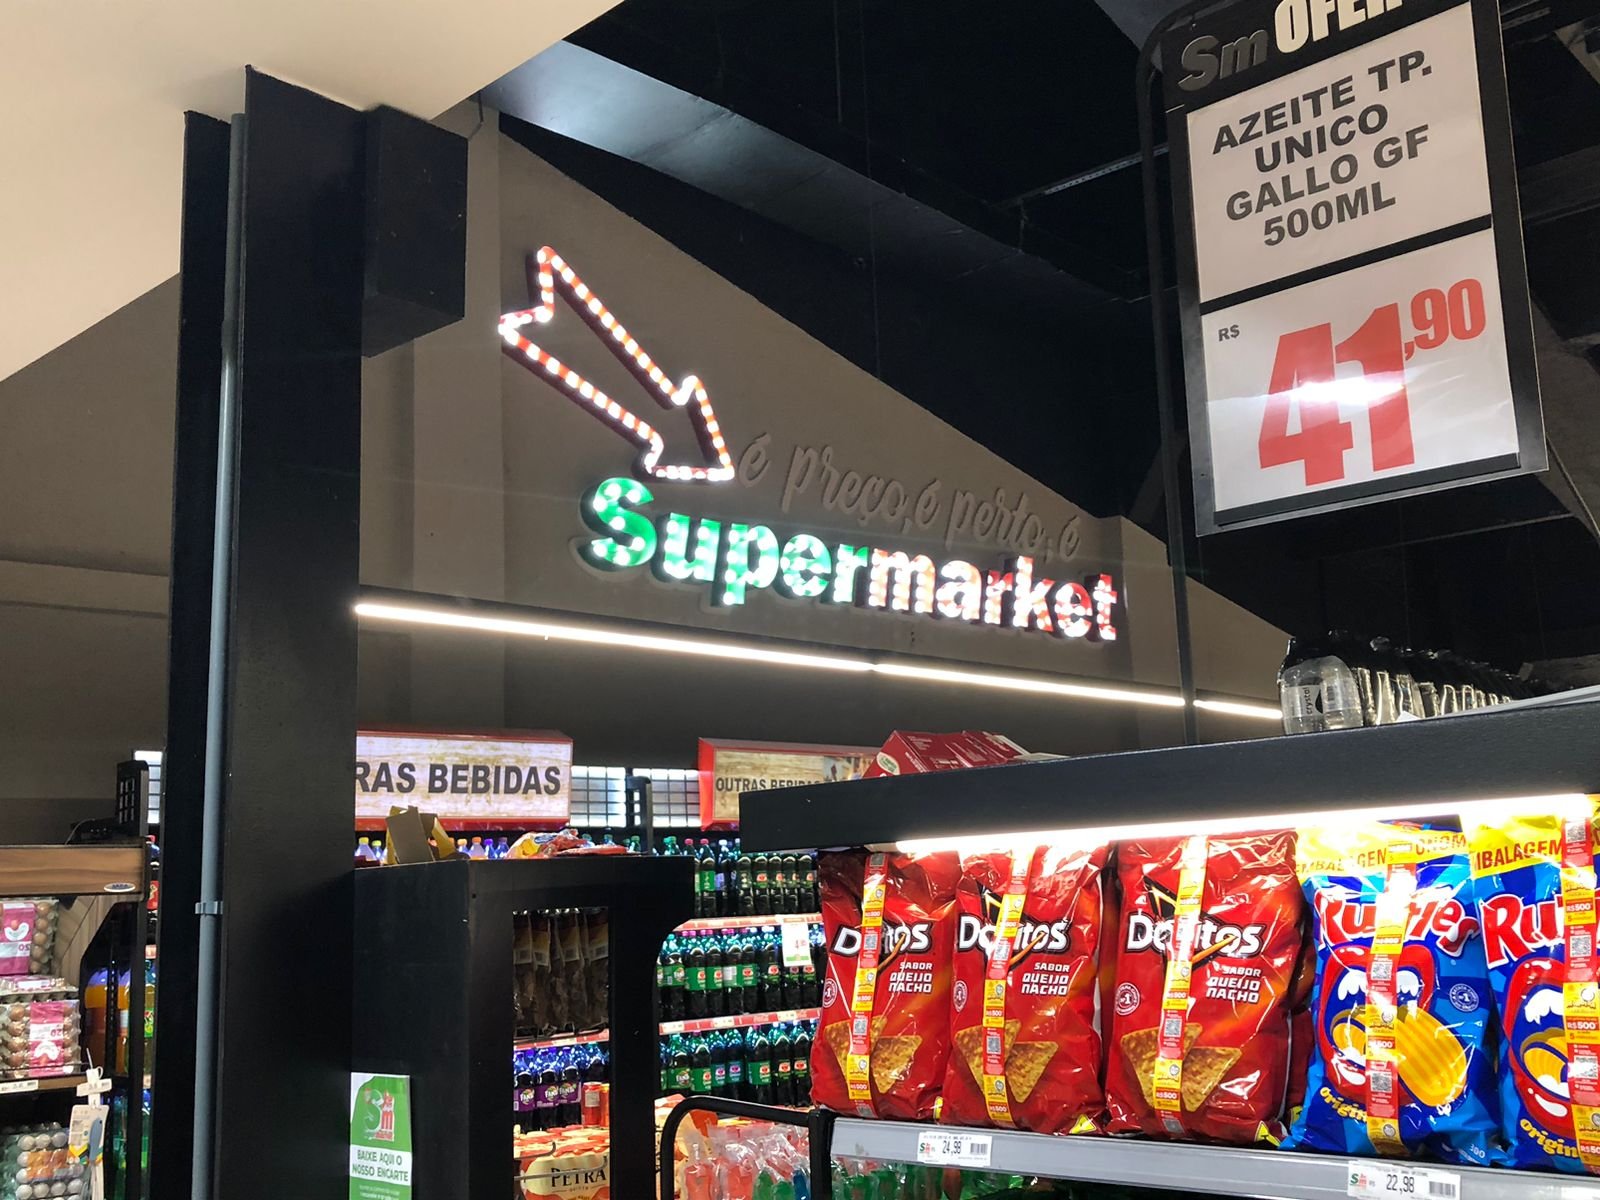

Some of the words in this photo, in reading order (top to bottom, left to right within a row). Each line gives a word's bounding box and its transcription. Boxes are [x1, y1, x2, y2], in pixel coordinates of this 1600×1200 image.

[1178, 29, 1269, 92] Sm
[1212, 75, 1356, 155] AZEITE
[1368, 50, 1432, 92] TP.
[1255, 104, 1389, 173] UNICO
[1226, 154, 1359, 221] GALLO
[1373, 124, 1429, 169] GF
[1264, 181, 1396, 246] 500ML
[1218, 324, 1240, 342] R$
[590, 477, 1118, 641] Supermarket
[1303, 687, 1314, 715] crystal
[428, 763, 561, 795] BEBIDAS
[900, 961, 933, 970] SABOR
[1034, 962, 1070, 972] SABOR
[889, 972, 933, 983] QUEIJO
[1022, 973, 1070, 985] QUEIJO
[1207, 976, 1261, 992] QUEIJO
[888, 982, 932, 993] NACHO
[1021, 984, 1068, 996] NACHO
[1206, 987, 1259, 1004] NACHO
[357, 1150, 377, 1161] BAIXE
[380, 1151, 395, 1166] AQUI
[396, 1155, 403, 1166] O
[352, 1163, 375, 1177] NOSSO
[377, 1167, 409, 1182] ENCARTE
[551, 1167, 607, 1188] PETRA
[1386, 1173, 1415, 1195] 22,98
